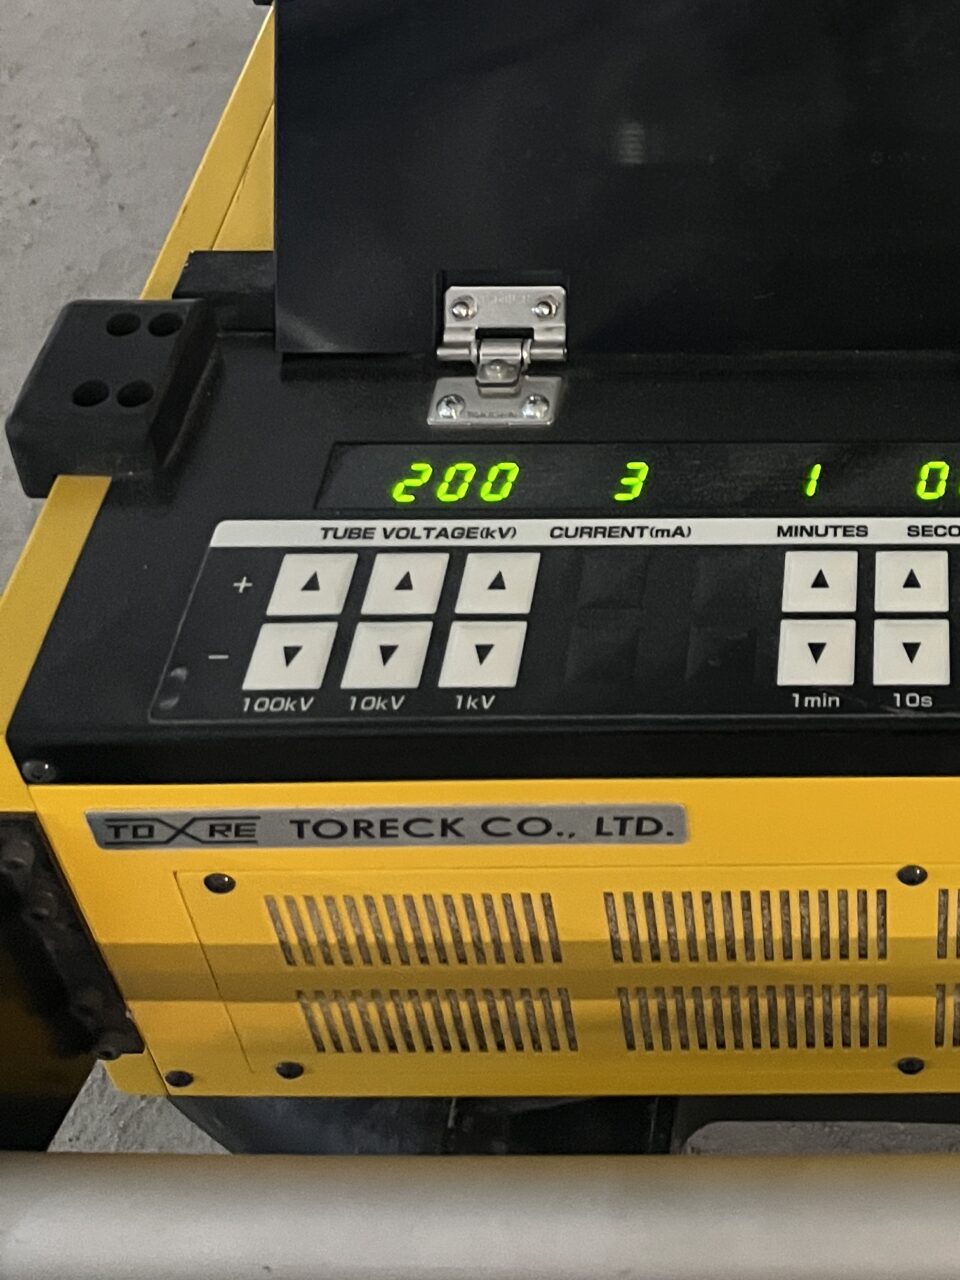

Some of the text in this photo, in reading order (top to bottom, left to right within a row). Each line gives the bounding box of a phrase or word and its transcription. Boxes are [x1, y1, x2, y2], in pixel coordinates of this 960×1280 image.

[392, 462, 520, 502] 200
[614, 461, 649, 501] 3
[806, 464, 821, 496] 1
[320, 526, 517, 540] TUBE VOLTAGE(kV)
[550, 525, 691, 539] CURRENT(mA)
[777, 525, 868, 538] MINUTES
[242, 696, 314, 712] 100kV
[349, 695, 405, 711] 10kV
[456, 694, 496, 710] 1kV
[791, 693, 840, 708] 1min
[893, 693, 933, 708] 10s
[289, 816, 464, 839] TORECK
[480, 817, 576, 839] CO.,
[594, 815, 675, 838] LTD.
